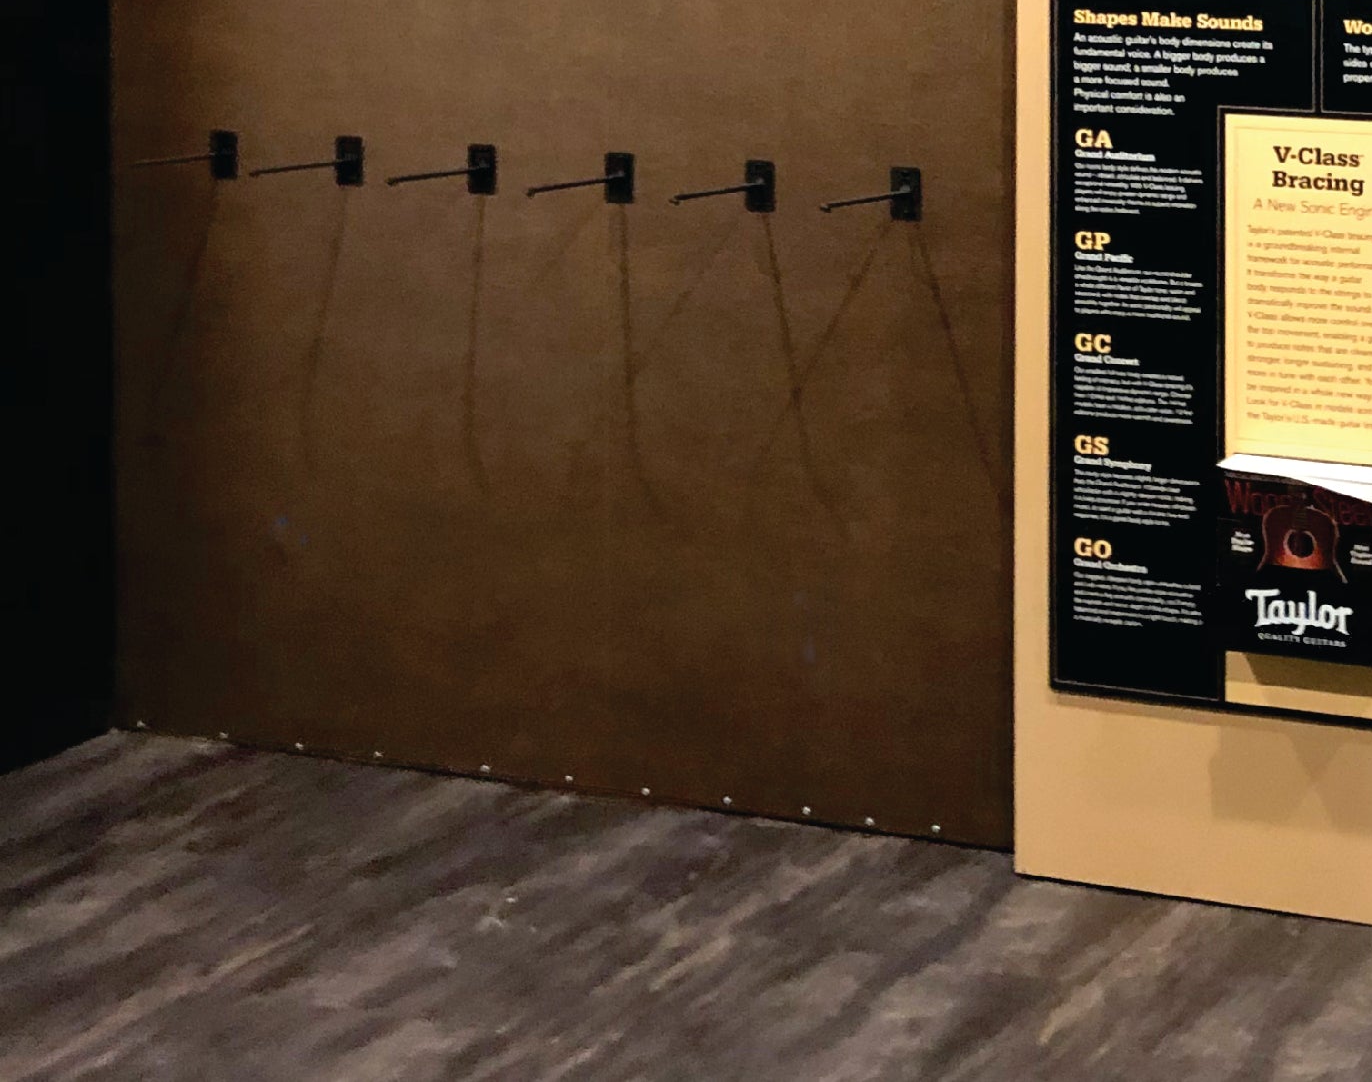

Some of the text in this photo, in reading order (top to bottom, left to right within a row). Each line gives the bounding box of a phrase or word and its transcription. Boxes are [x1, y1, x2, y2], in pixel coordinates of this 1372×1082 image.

[1073, 9, 1263, 31] Shapes Make Sounds
[1074, 129, 1113, 149] GA
[1272, 171, 1365, 196] Bracing
[1268, 199, 1296, 212] New
[1301, 201, 1334, 214] Sonic
[1074, 231, 1111, 250] GP
[1074, 333, 1112, 353] GC
[1074, 435, 1110, 455] GS
[1074, 538, 1112, 558] GO
[1245, 589, 1354, 636] Taylor
[1257, 633, 1347, 647] QUALITY GUITARS
